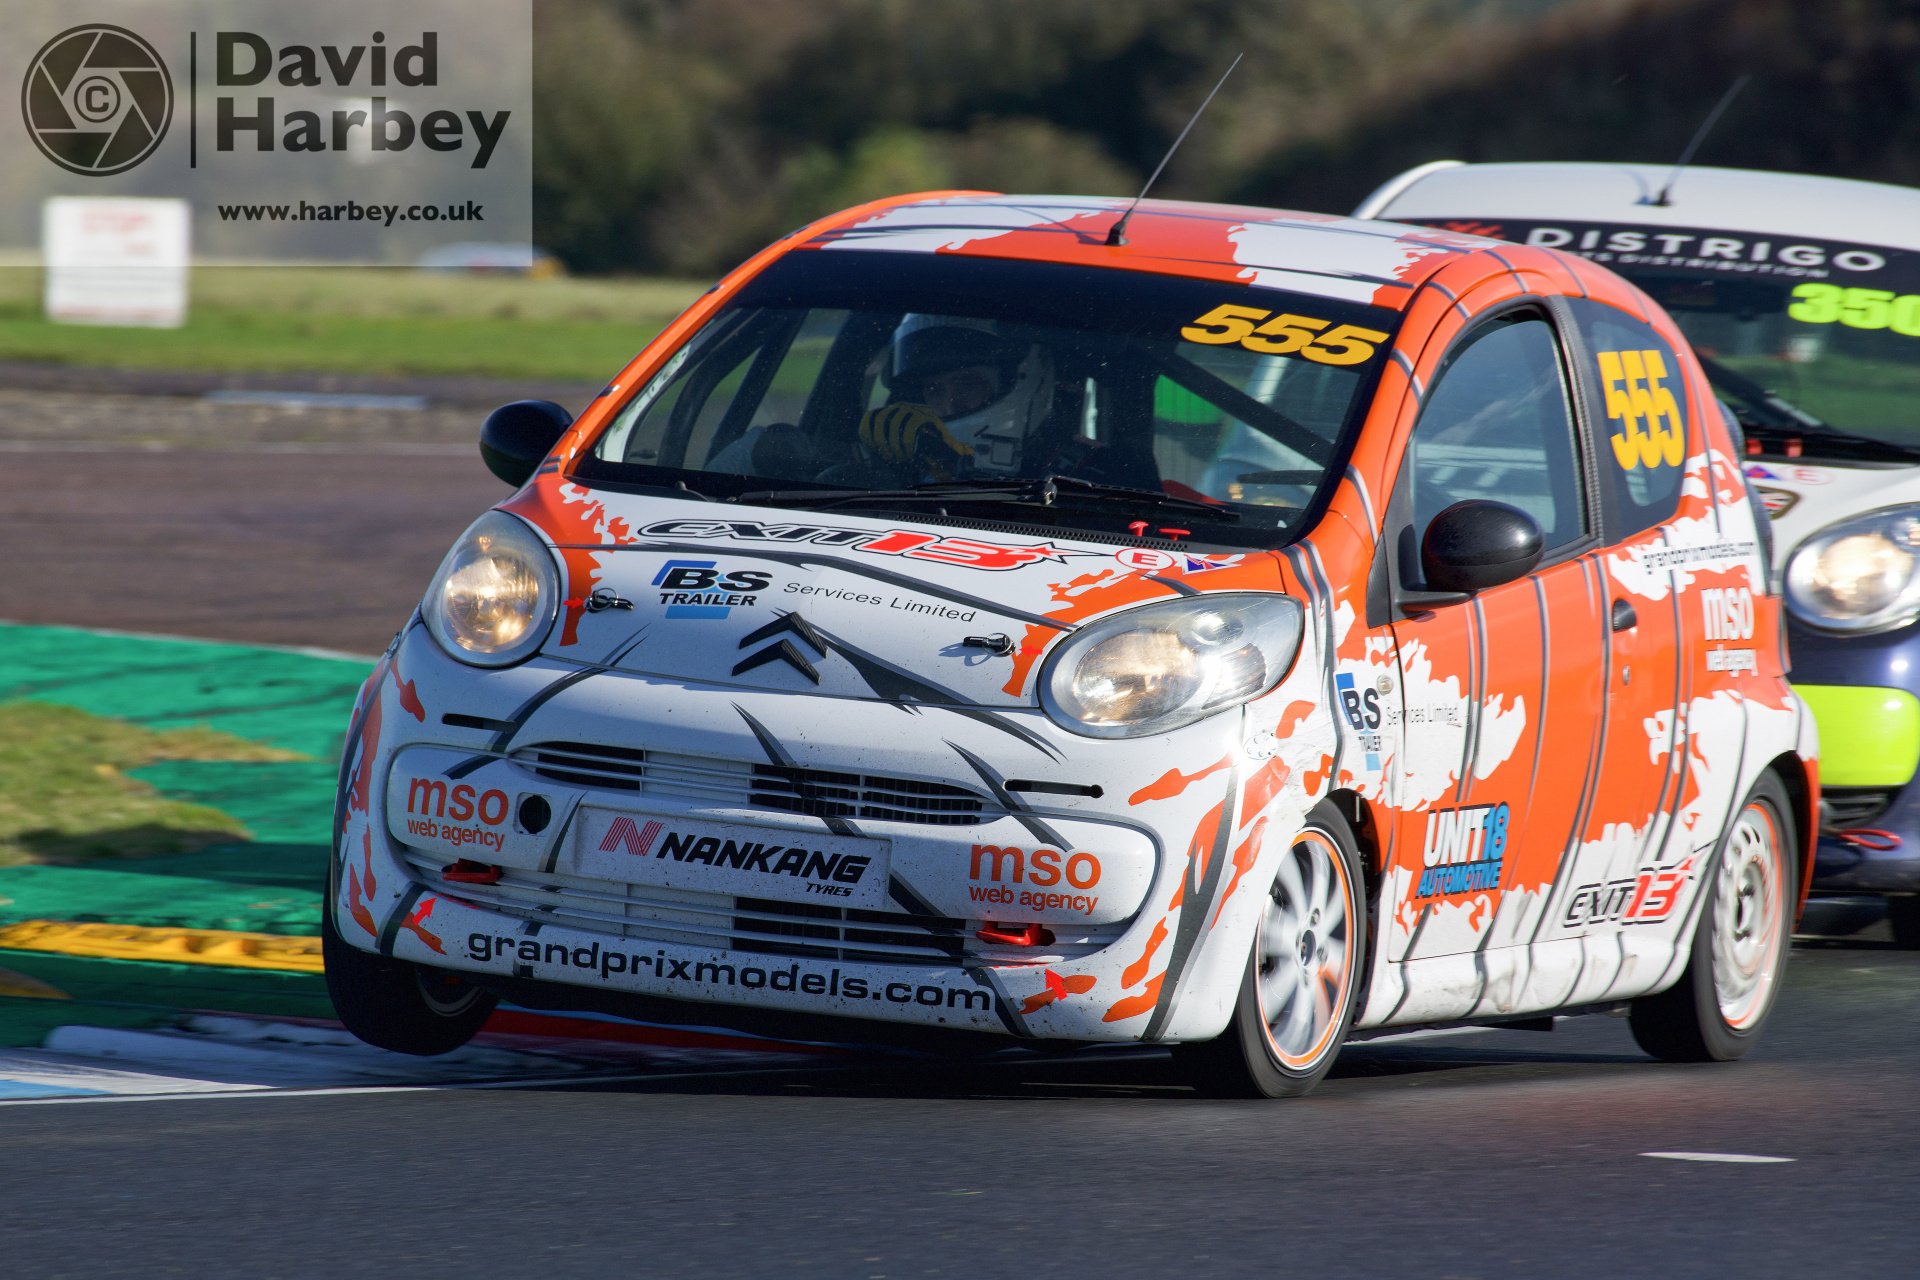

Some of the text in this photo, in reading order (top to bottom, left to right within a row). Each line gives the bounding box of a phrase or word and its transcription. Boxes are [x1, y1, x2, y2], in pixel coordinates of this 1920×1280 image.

[1526, 227, 1887, 272] DISTRIGO
[1180, 303, 1391, 366] 555
[1597, 349, 1685, 471] 555
[659, 592, 758, 607] TRAILER
[784, 581, 977, 623] Services Limited
[1701, 586, 1755, 642] mso
[407, 775, 510, 828] mso
[407, 815, 505, 853] web agency
[656, 831, 872, 884] NANKANG
[1422, 801, 1511, 869] UNIT18
[804, 881, 855, 898] TYRES
[968, 842, 1102, 890] mso
[1415, 860, 1503, 900] AUTOMOTIVE
[968, 884, 1099, 916] web agency
[468, 931, 990, 1012] grandprixmodels.com
